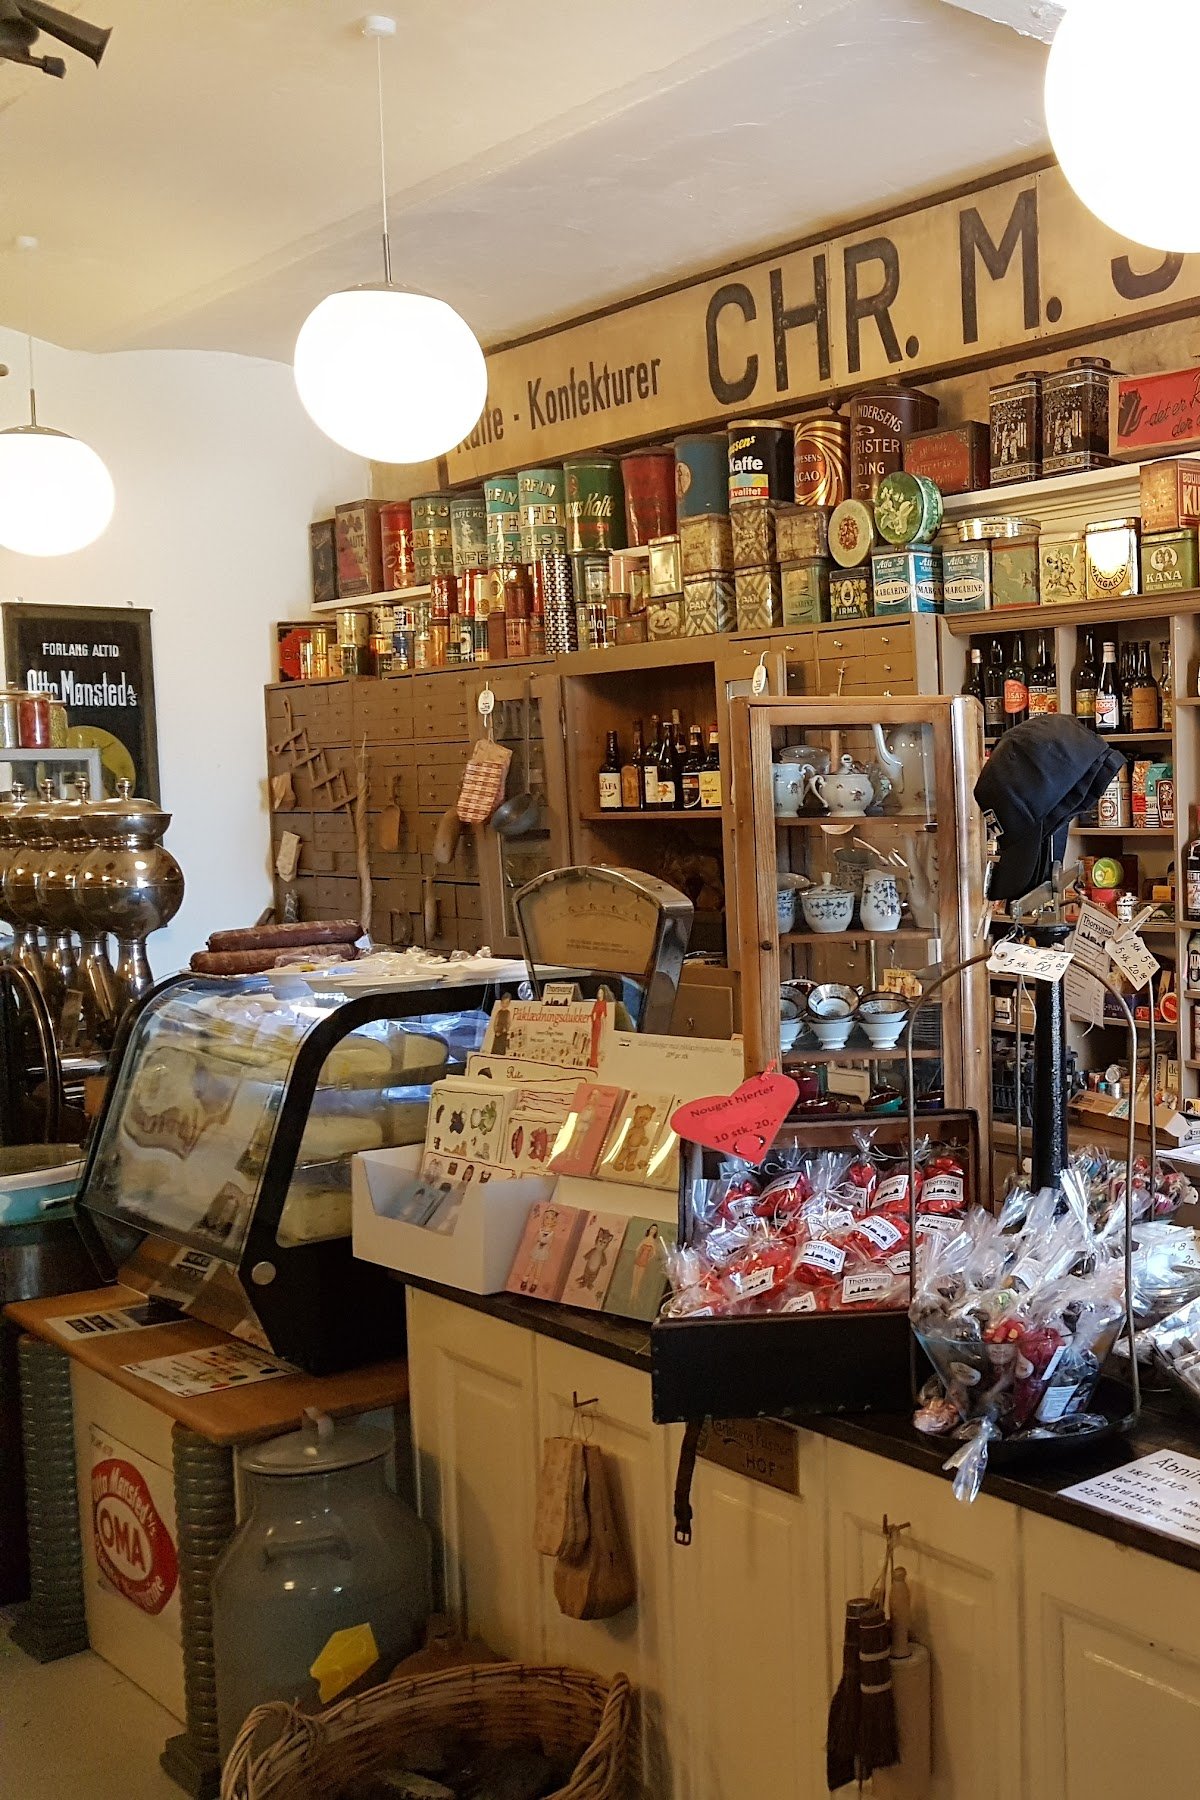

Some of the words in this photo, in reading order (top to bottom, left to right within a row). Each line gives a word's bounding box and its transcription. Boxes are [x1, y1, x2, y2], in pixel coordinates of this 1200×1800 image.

[705, 237, 920, 405] CHR.
[959, 187, 1063, 345] M.
[527, 358, 661, 430] Konfekturer
[729, 456, 763, 471] Kaffe
[584, 493, 614, 518] Kaffe
[1146, 571, 1182, 584] KANA
[688, 601, 708, 613] PAN
[838, 605, 858, 616] IRMA
[42, 643, 88, 657] FORLANG
[92, 644, 119, 658] ALTID
[27, 669, 58, 694] Otto
[61, 670, 126, 707] Mønsted
[1189, 957, 1200, 969] ATA
[690, 1098, 733, 1119] Nougat
[734, 1083, 776, 1109] hjerter
[713, 1132, 729, 1145] 10
[731, 1125, 752, 1139] stk.
[755, 1117, 778, 1130] 20,-
[926, 1179, 959, 1188] Thorsvang
[805, 1243, 842, 1258] Thorsvang
[99, 1507, 147, 1573] OMA
